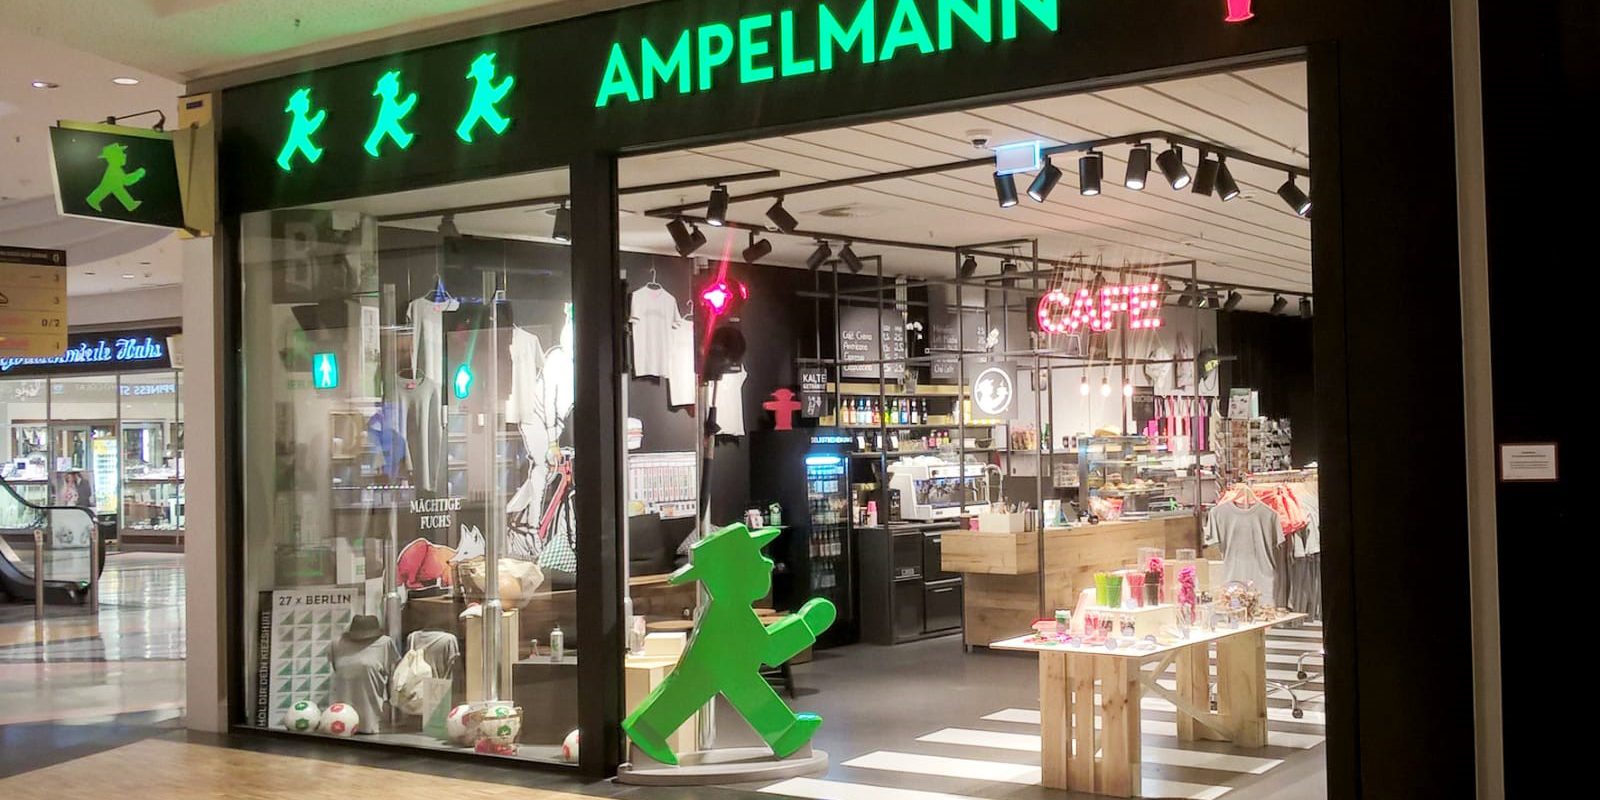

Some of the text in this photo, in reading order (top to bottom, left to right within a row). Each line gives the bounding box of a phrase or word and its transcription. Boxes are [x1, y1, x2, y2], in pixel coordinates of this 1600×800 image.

[595, 0, 1058, 107] AMPELMANN
[1036, 284, 1161, 334] CAFE
[803, 373, 827, 384] KALTE
[420, 515, 452, 529] FUCHS
[279, 596, 292, 606] 27
[306, 594, 352, 605] BERLIN
[259, 662, 269, 685] DEIN
[259, 686, 268, 705] DIR
[257, 706, 267, 727] HOL
